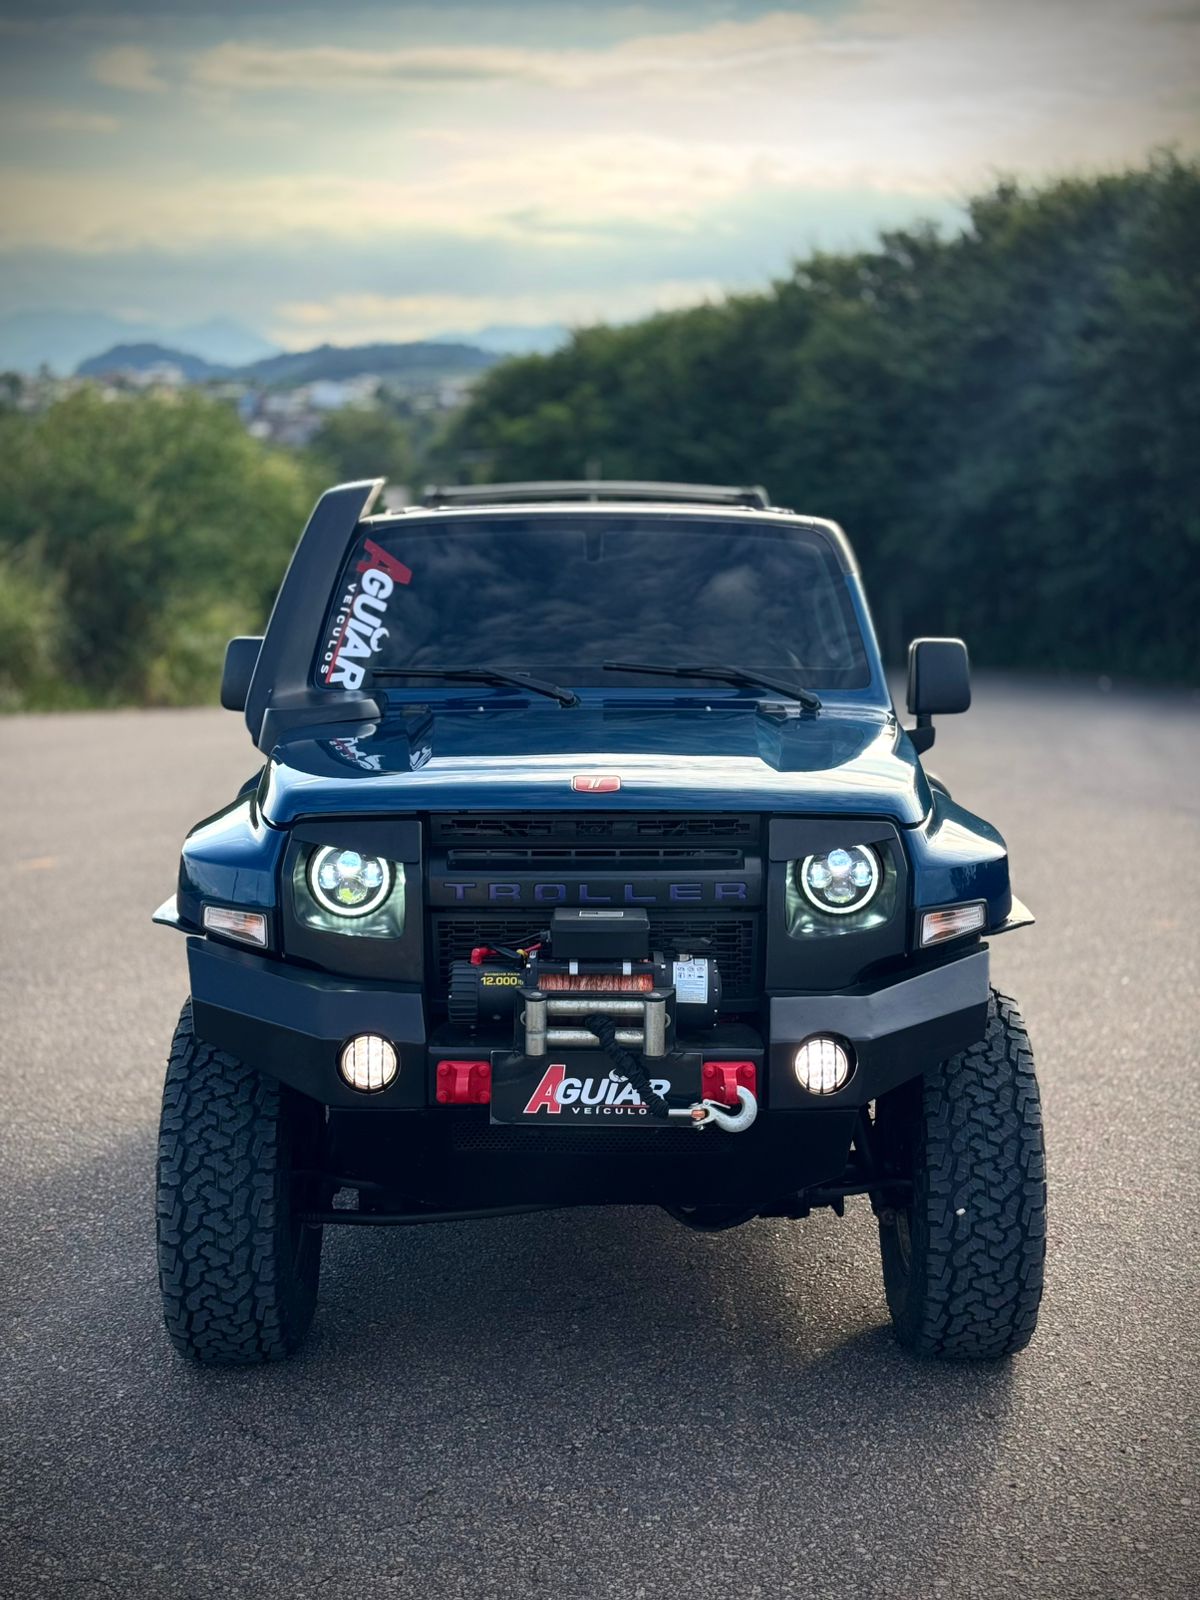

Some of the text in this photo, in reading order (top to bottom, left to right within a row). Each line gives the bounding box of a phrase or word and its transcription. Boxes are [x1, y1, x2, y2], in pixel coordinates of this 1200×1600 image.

[330, 538, 412, 690] AGUIAR
[444, 883, 748, 900] TROLLER
[480, 976, 517, 986] 12.000
[572, 1105, 649, 1115] VEÍCULO
